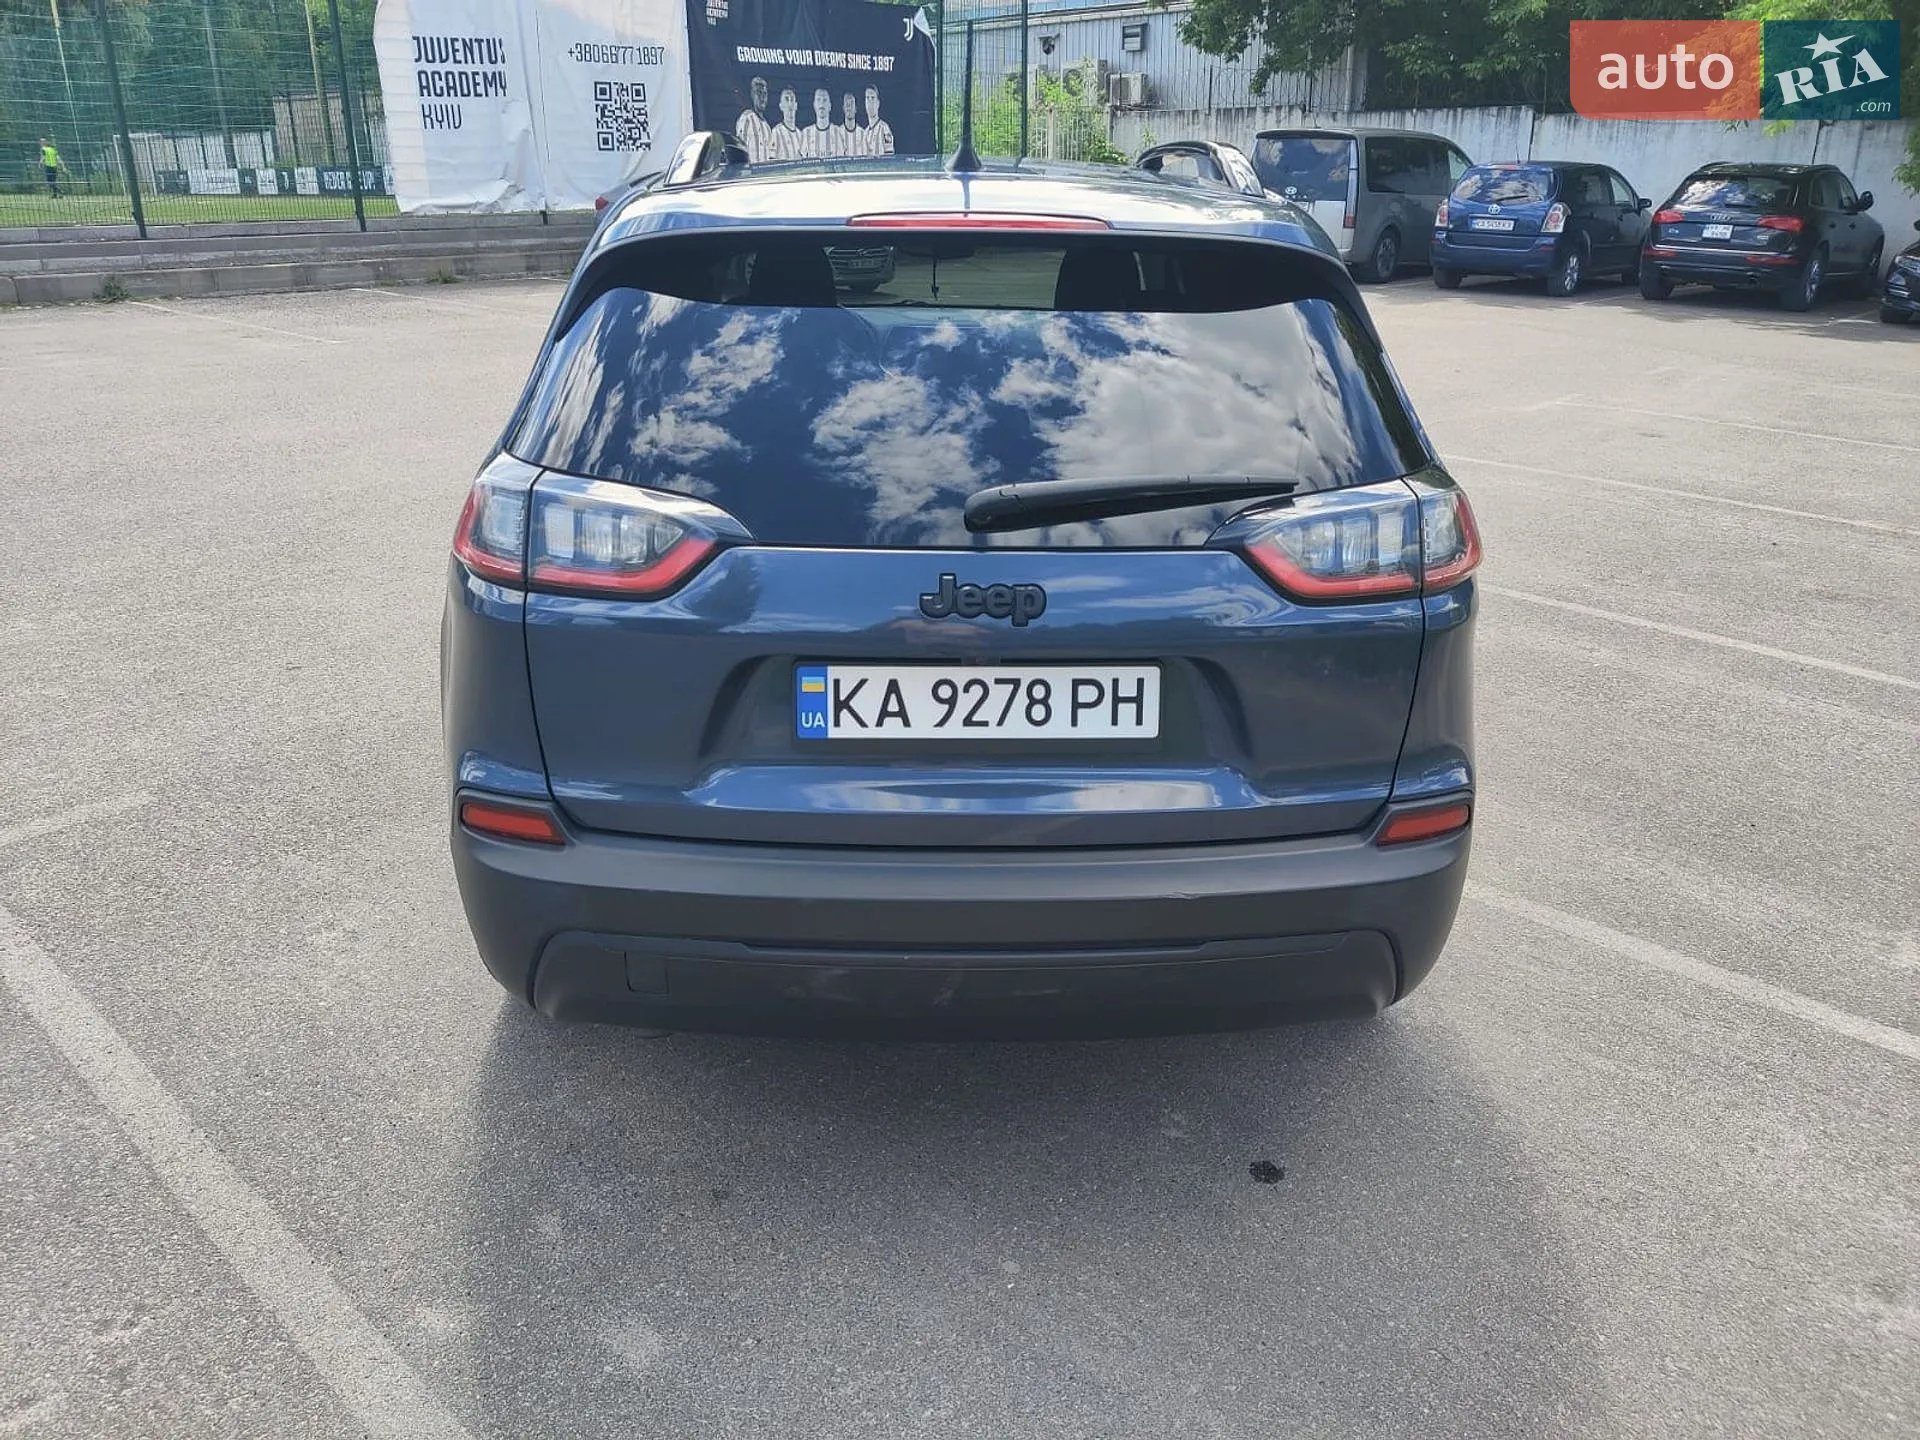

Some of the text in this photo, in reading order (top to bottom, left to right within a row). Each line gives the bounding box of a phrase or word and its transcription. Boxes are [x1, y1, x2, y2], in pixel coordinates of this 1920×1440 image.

[737, 45, 896, 72] GROWING YOUR DREAMS SINCE 1897
[417, 70, 507, 97] ACADEMY
[421, 103, 462, 130] KYIV
[918, 572, 1048, 628] Jeep
[832, 677, 1146, 729] KA 9278 PH
[801, 710, 826, 728] UA
